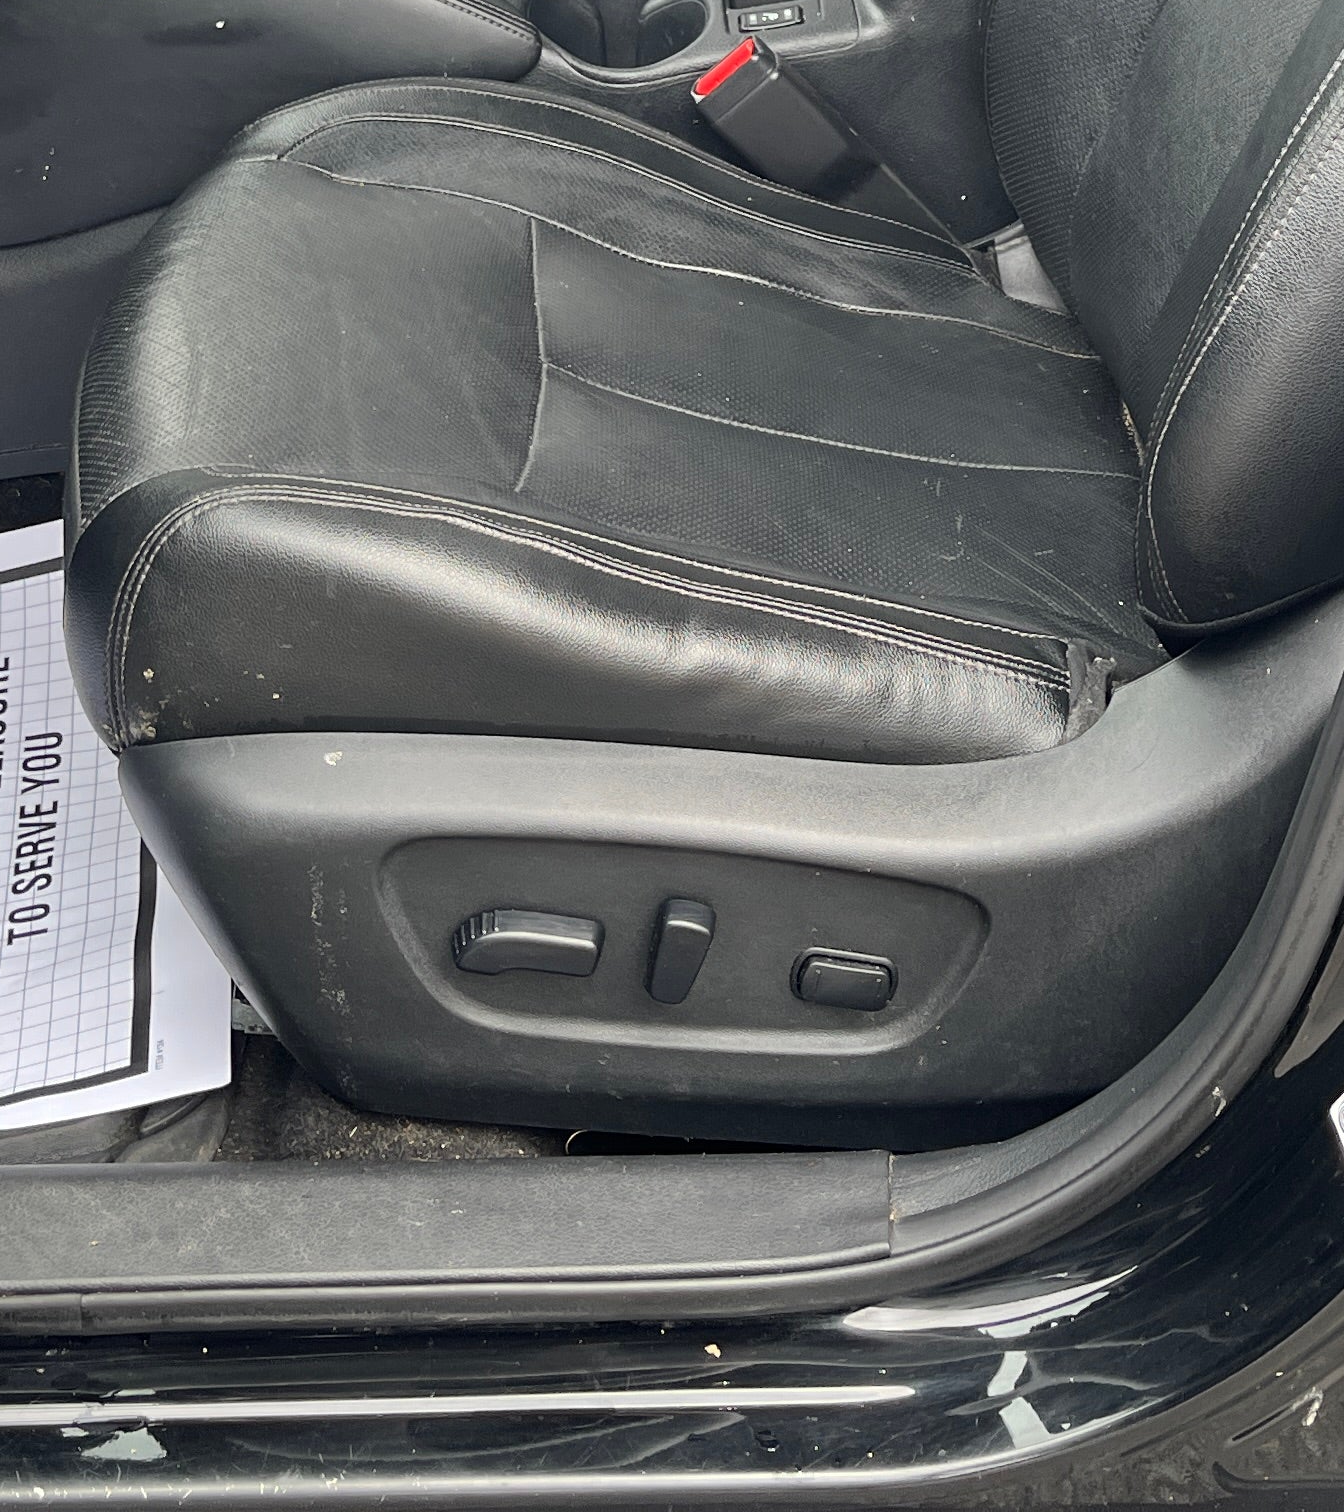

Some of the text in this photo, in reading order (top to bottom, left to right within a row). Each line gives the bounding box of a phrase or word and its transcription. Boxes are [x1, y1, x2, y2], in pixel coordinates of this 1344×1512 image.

[7, 731, 63, 946] TO SERVE YOU
